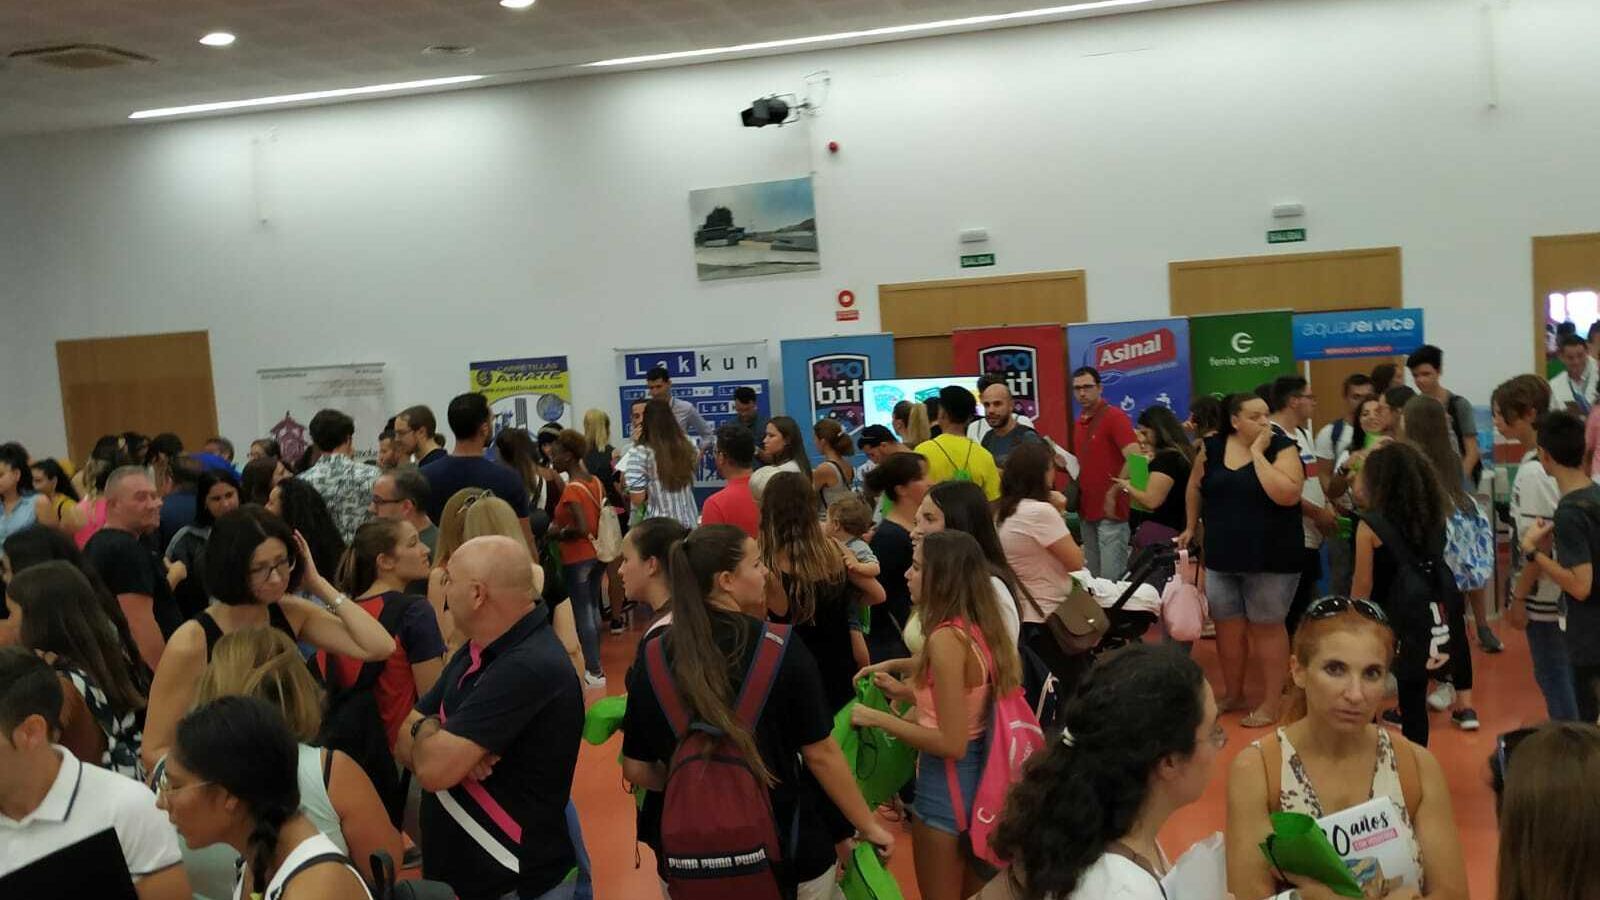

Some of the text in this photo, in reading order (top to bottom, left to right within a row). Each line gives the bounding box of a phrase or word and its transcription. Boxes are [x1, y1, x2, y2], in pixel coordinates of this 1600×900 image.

[1099, 333, 1162, 367] Asinal
[633, 354, 758, 376] Lakkun
[814, 360, 864, 380] XPO
[984, 352, 1031, 372] XPO
[815, 380, 864, 405] bit
[1003, 371, 1032, 396] it
[668, 848, 767, 870] PUMA PUMA PUMA
